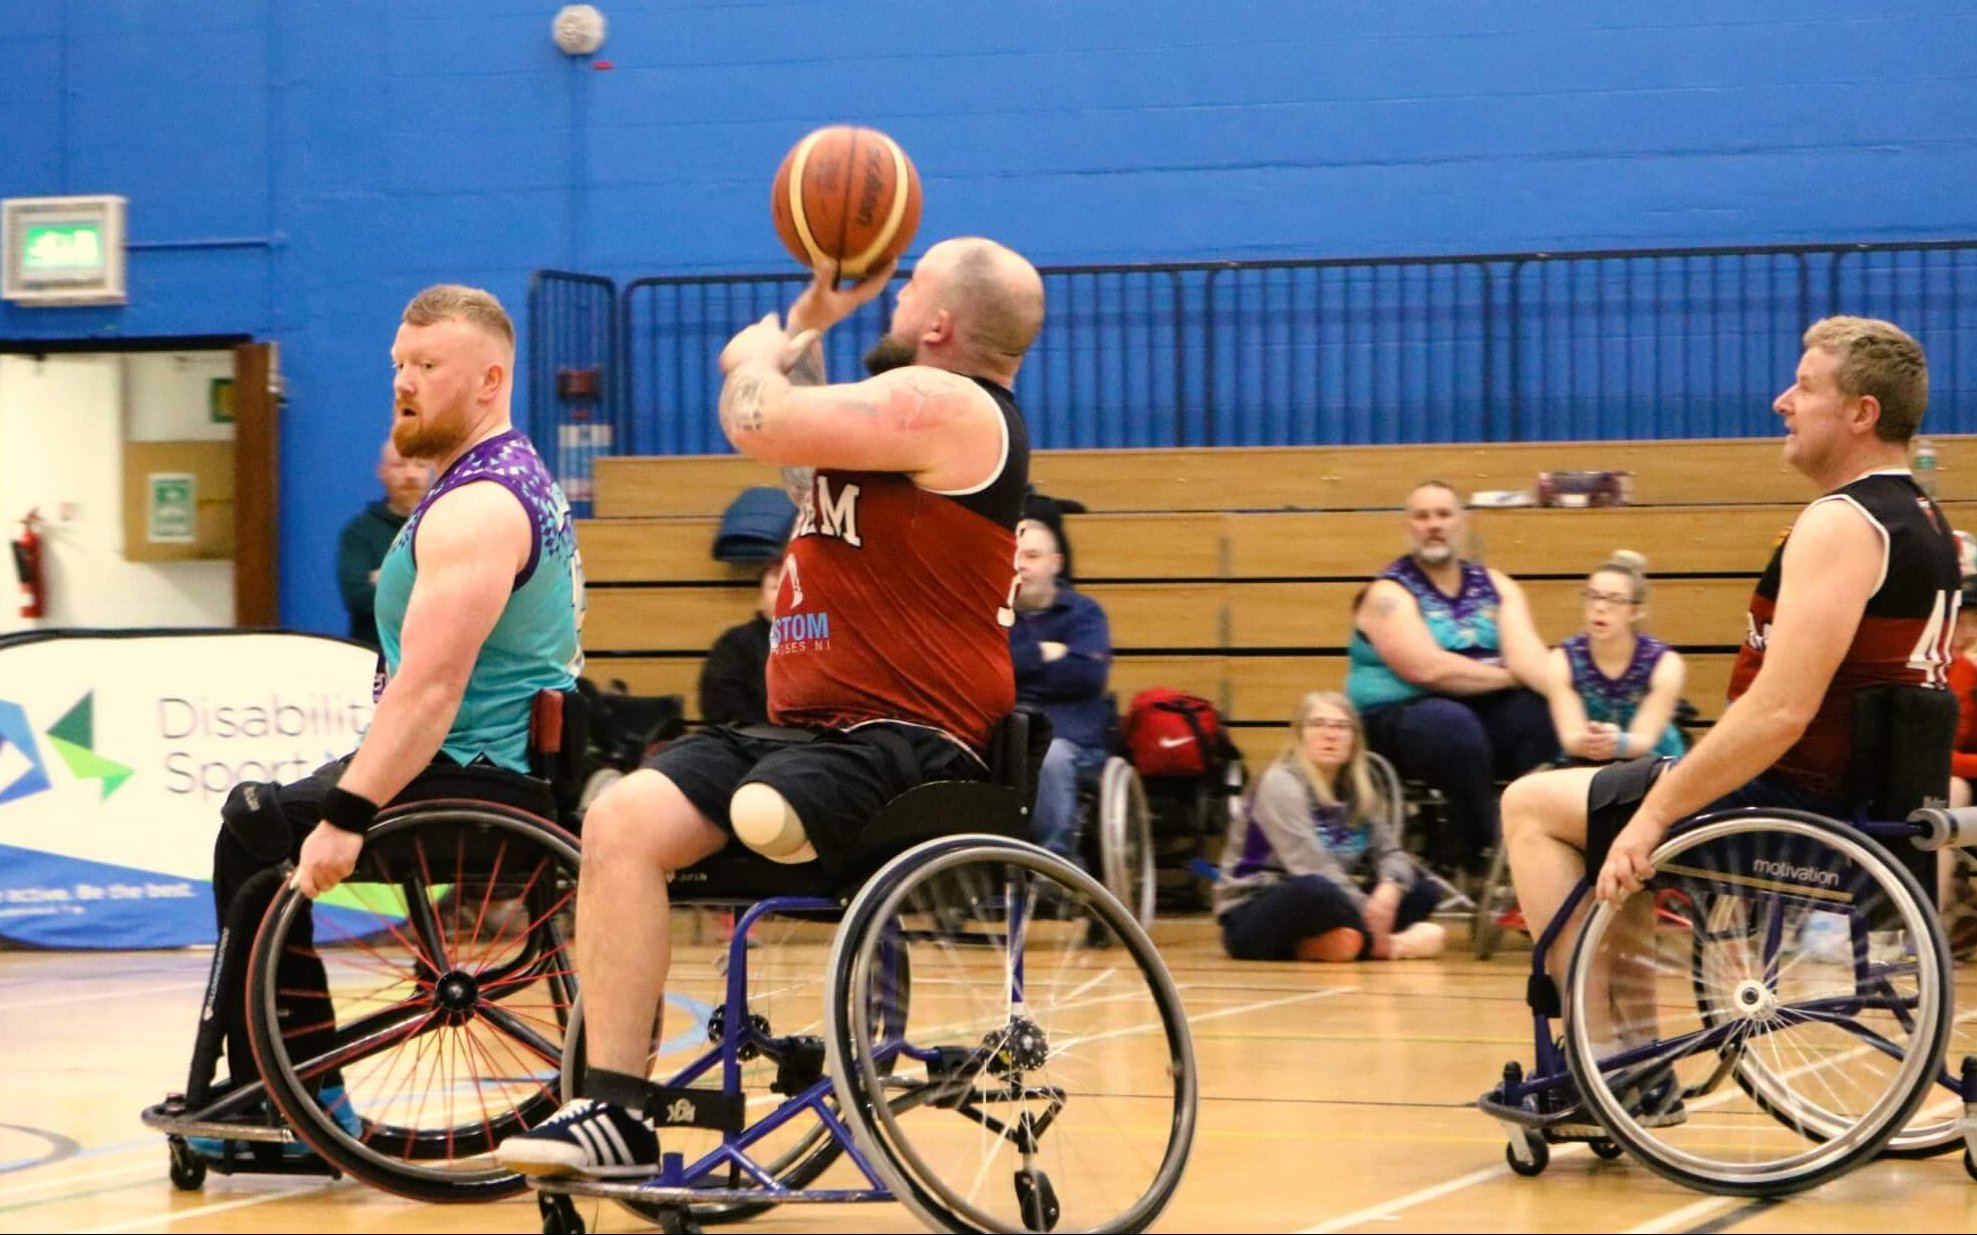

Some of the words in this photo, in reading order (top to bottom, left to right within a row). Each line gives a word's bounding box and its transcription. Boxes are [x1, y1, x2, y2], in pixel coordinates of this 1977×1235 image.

[769, 612, 830, 644] STOM
[159, 696, 373, 740] Disabilit
[1753, 859, 1840, 887] motivation
